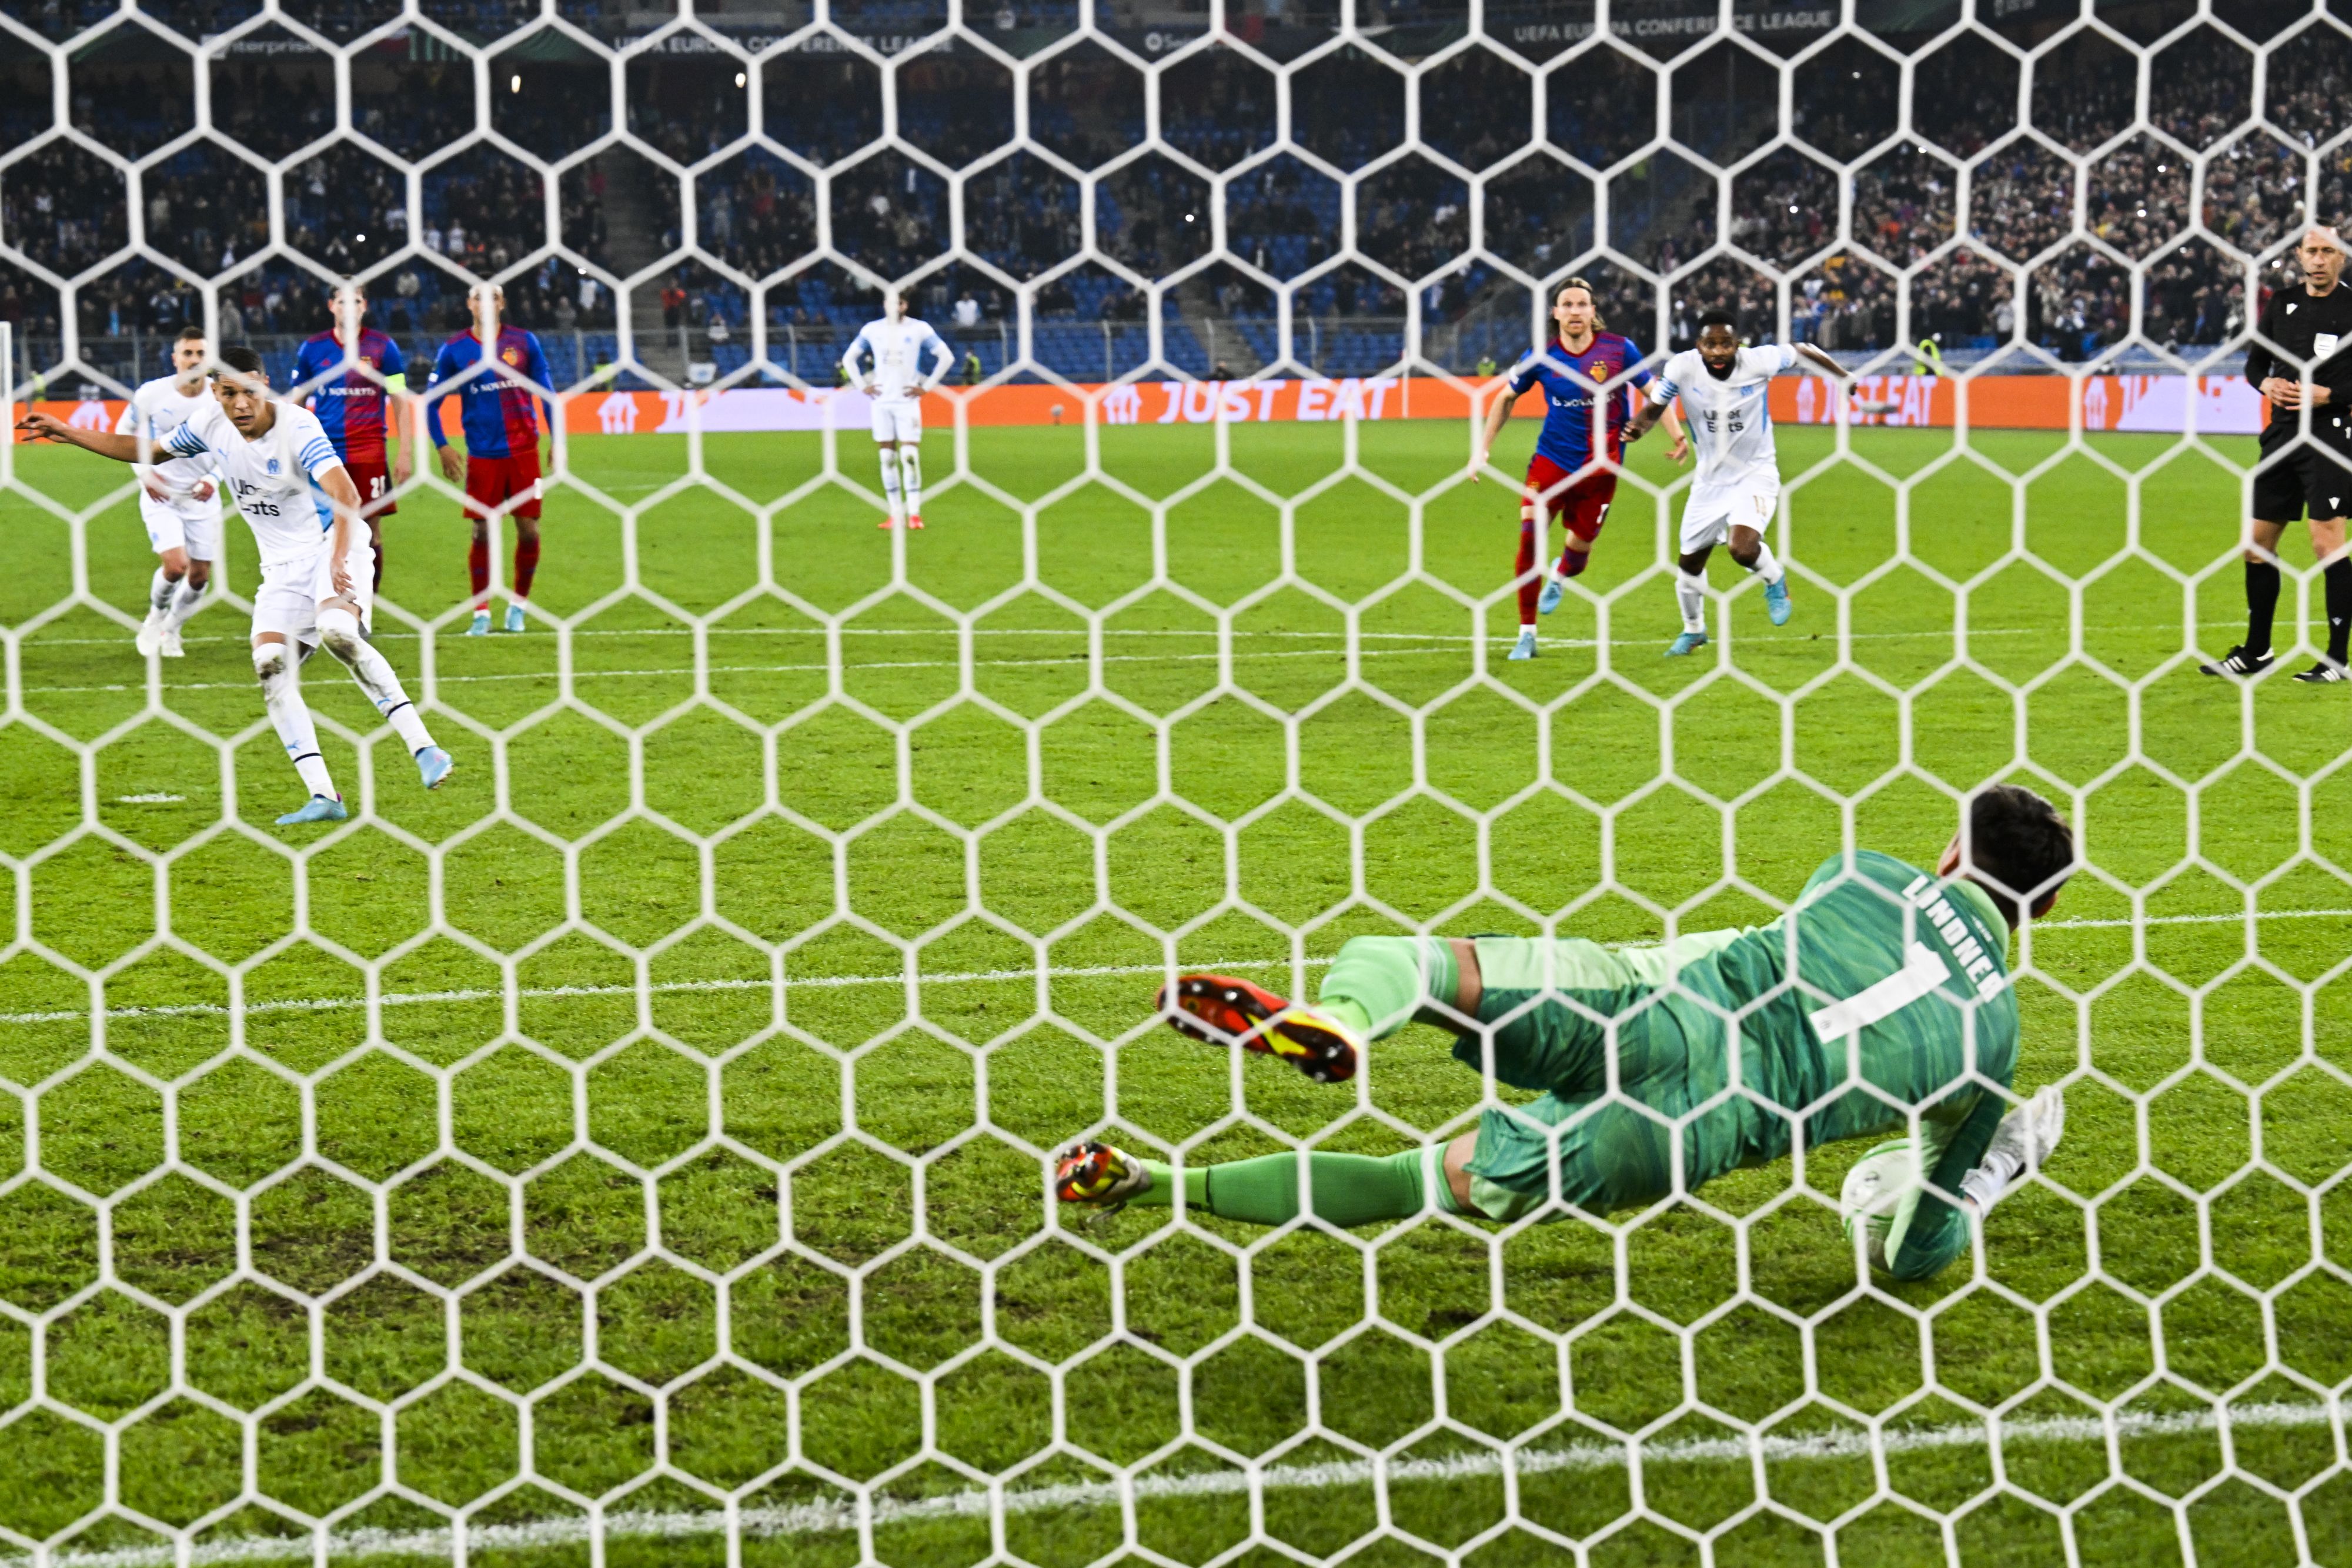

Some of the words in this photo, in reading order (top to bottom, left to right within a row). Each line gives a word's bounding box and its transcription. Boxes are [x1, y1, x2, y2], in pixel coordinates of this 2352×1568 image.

[1514, 24, 1559, 42] UEFA
[1563, 21, 1633, 40] EURPA
[1635, 14, 1755, 36] CONFERECE
[1760, 9, 1833, 29] LEAGUE
[1157, 380, 1287, 423] JUST
[1297, 377, 1397, 420] EAT
[1885, 376, 1937, 426] EAT
[1706, 421, 1744, 433] Ets
[1902, 874, 2005, 1004] LINDNER
[1809, 940, 1952, 1045] 1
